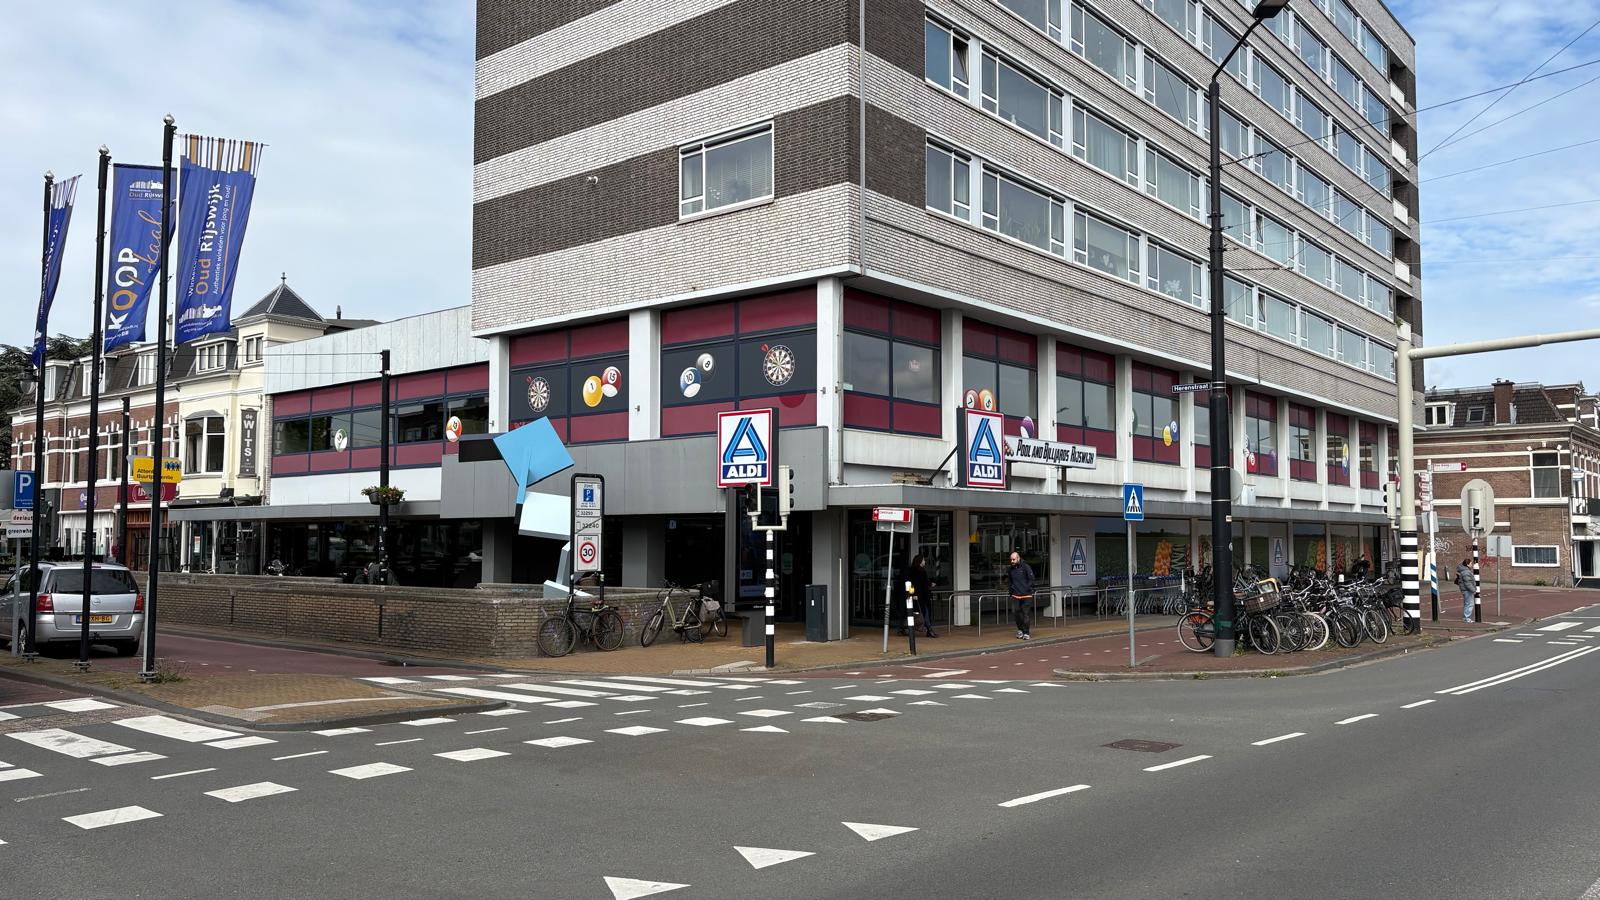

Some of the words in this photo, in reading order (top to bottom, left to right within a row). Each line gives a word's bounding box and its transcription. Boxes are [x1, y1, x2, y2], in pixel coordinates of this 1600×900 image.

[199, 183, 223, 252] Rijswijk
[195, 258, 212, 295] Oud
[212, 262, 222, 295] Authentiek
[108, 247, 140, 330] KOOP
[609, 372, 616, 380] 15
[685, 373, 693, 382] 10
[1174, 383, 1209, 392] Herenstraat
[243, 420, 255, 457] WITS
[726, 464, 763, 478] ALDI
[972, 464, 998, 478] ALDI
[19, 474, 32, 494] P
[582, 548, 593, 557] 30
[1072, 564, 1085, 572] ALDI
